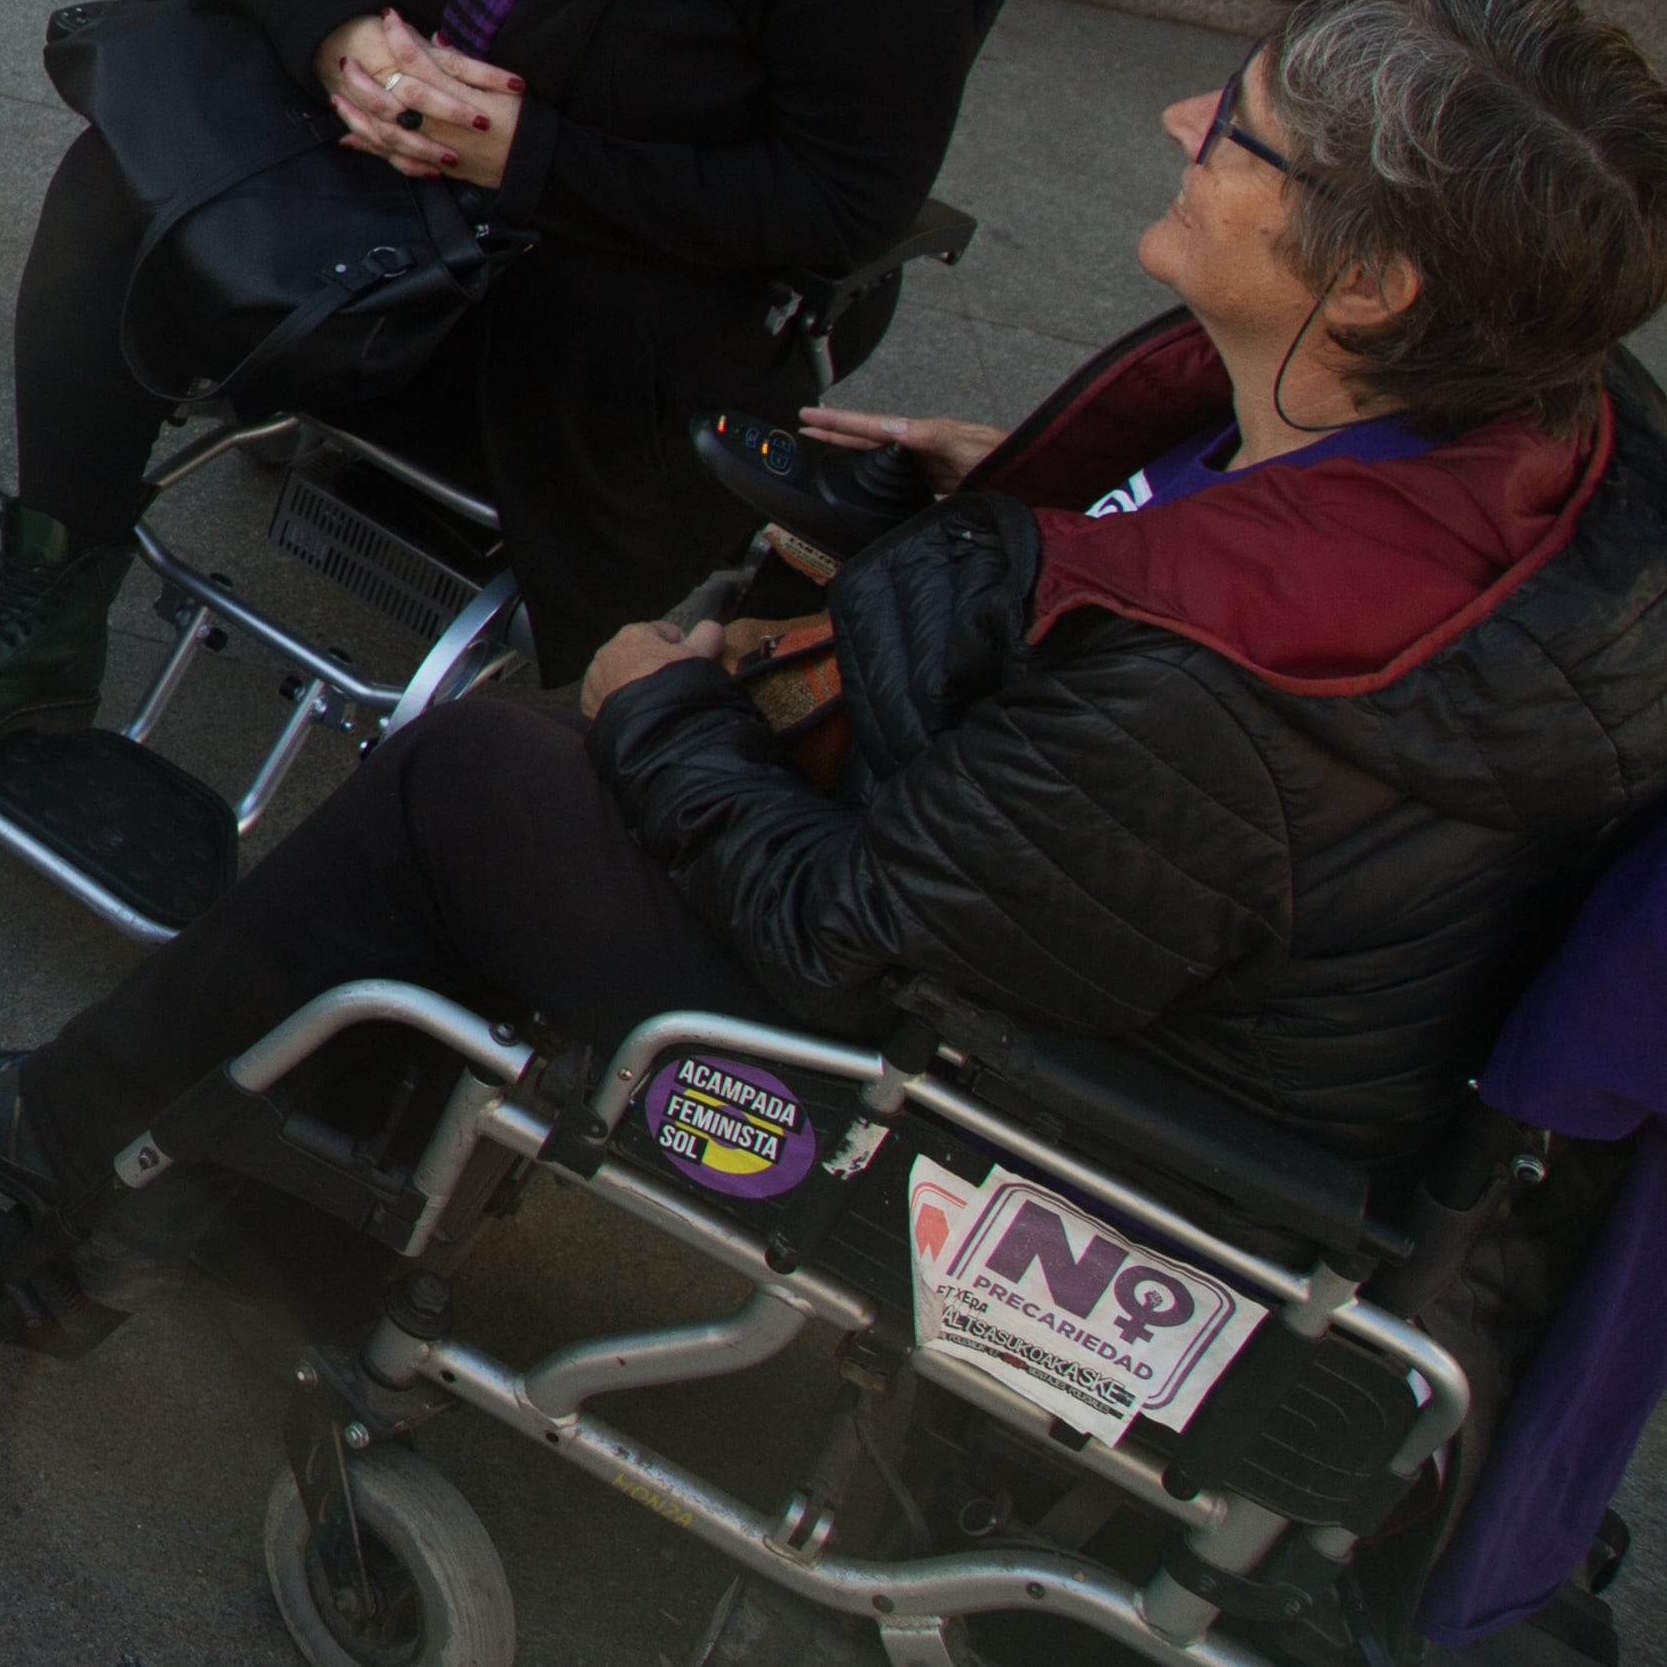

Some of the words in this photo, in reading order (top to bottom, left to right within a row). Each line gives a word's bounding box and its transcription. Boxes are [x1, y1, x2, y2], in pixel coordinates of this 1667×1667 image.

[678, 1060, 796, 1127] ACAMPADA
[659, 1124, 698, 1159] SOL
[666, 1095, 781, 1161] FEMINISTA
[972, 1275, 1153, 1380] PRECARIEDAD
